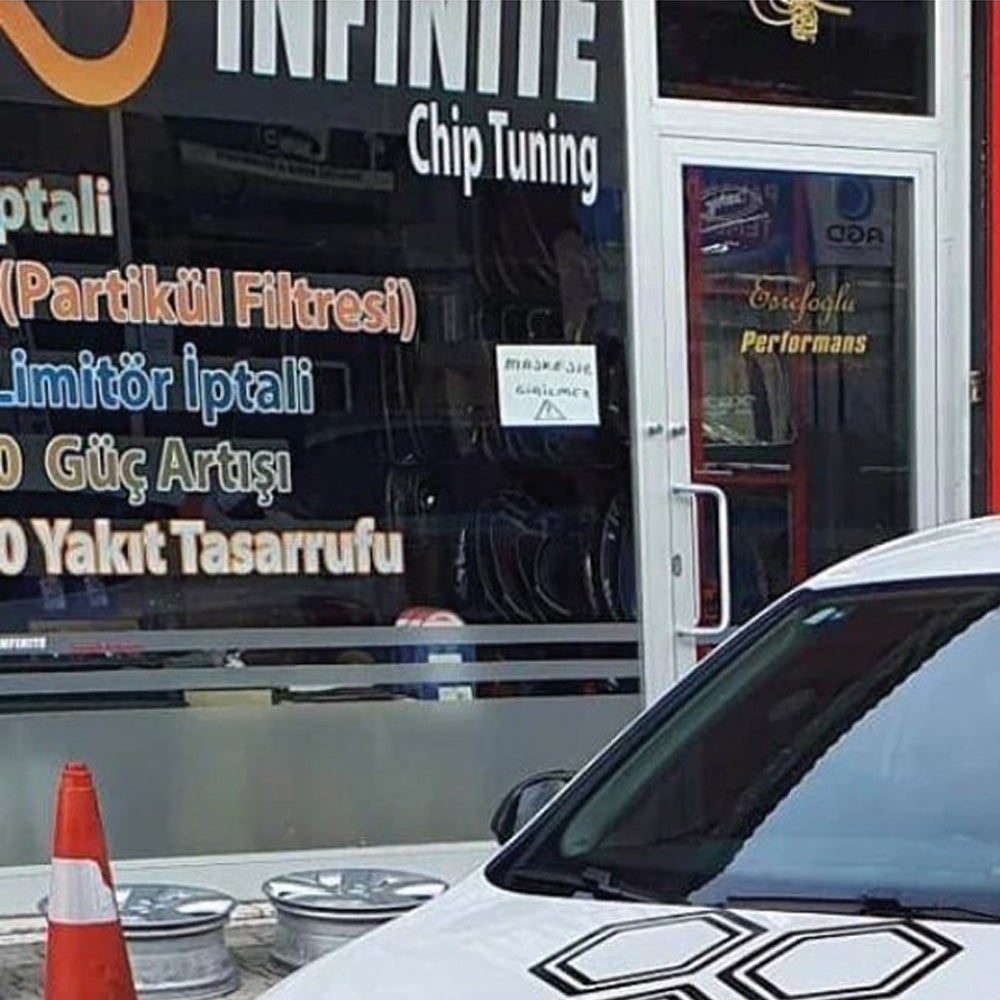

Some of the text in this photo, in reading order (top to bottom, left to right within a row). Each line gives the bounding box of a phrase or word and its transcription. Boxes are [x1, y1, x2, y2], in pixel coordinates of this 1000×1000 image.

[407, 101, 599, 206] Chip Tuning
[0, 259, 416, 342] (Partikül Filtresi)
[740, 329, 868, 354] Performans
[183, 341, 314, 427] İptali
[45, 433, 148, 506] Güç
[157, 436, 292, 506] Artışı
[31, 517, 168, 576] Yakıt
[169, 516, 404, 575] Tasarrufu
